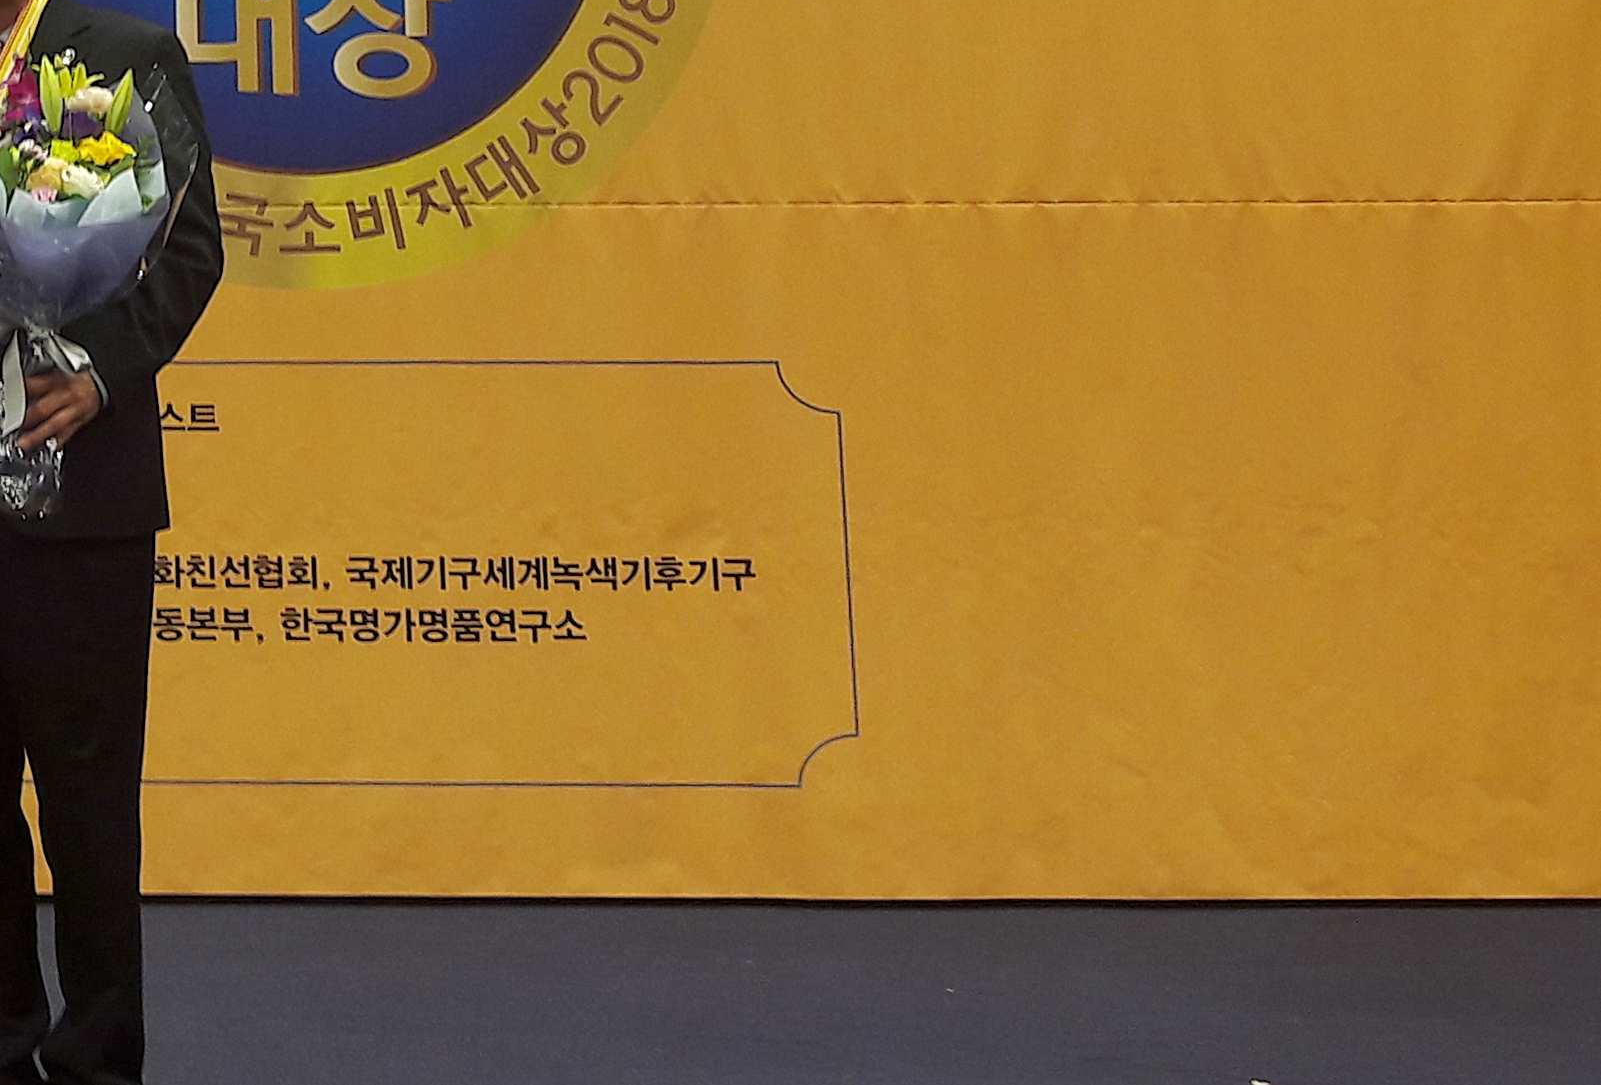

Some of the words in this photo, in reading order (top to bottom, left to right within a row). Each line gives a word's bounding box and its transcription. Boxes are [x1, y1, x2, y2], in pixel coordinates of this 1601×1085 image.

[160, 402, 220, 433] 스트
[154, 554, 331, 591] 화친선협회,
[346, 553, 757, 591] 국제기구세계녹색기후기구
[153, 606, 264, 645] 동본부,
[280, 606, 587, 644] 한국명가명품연구소
